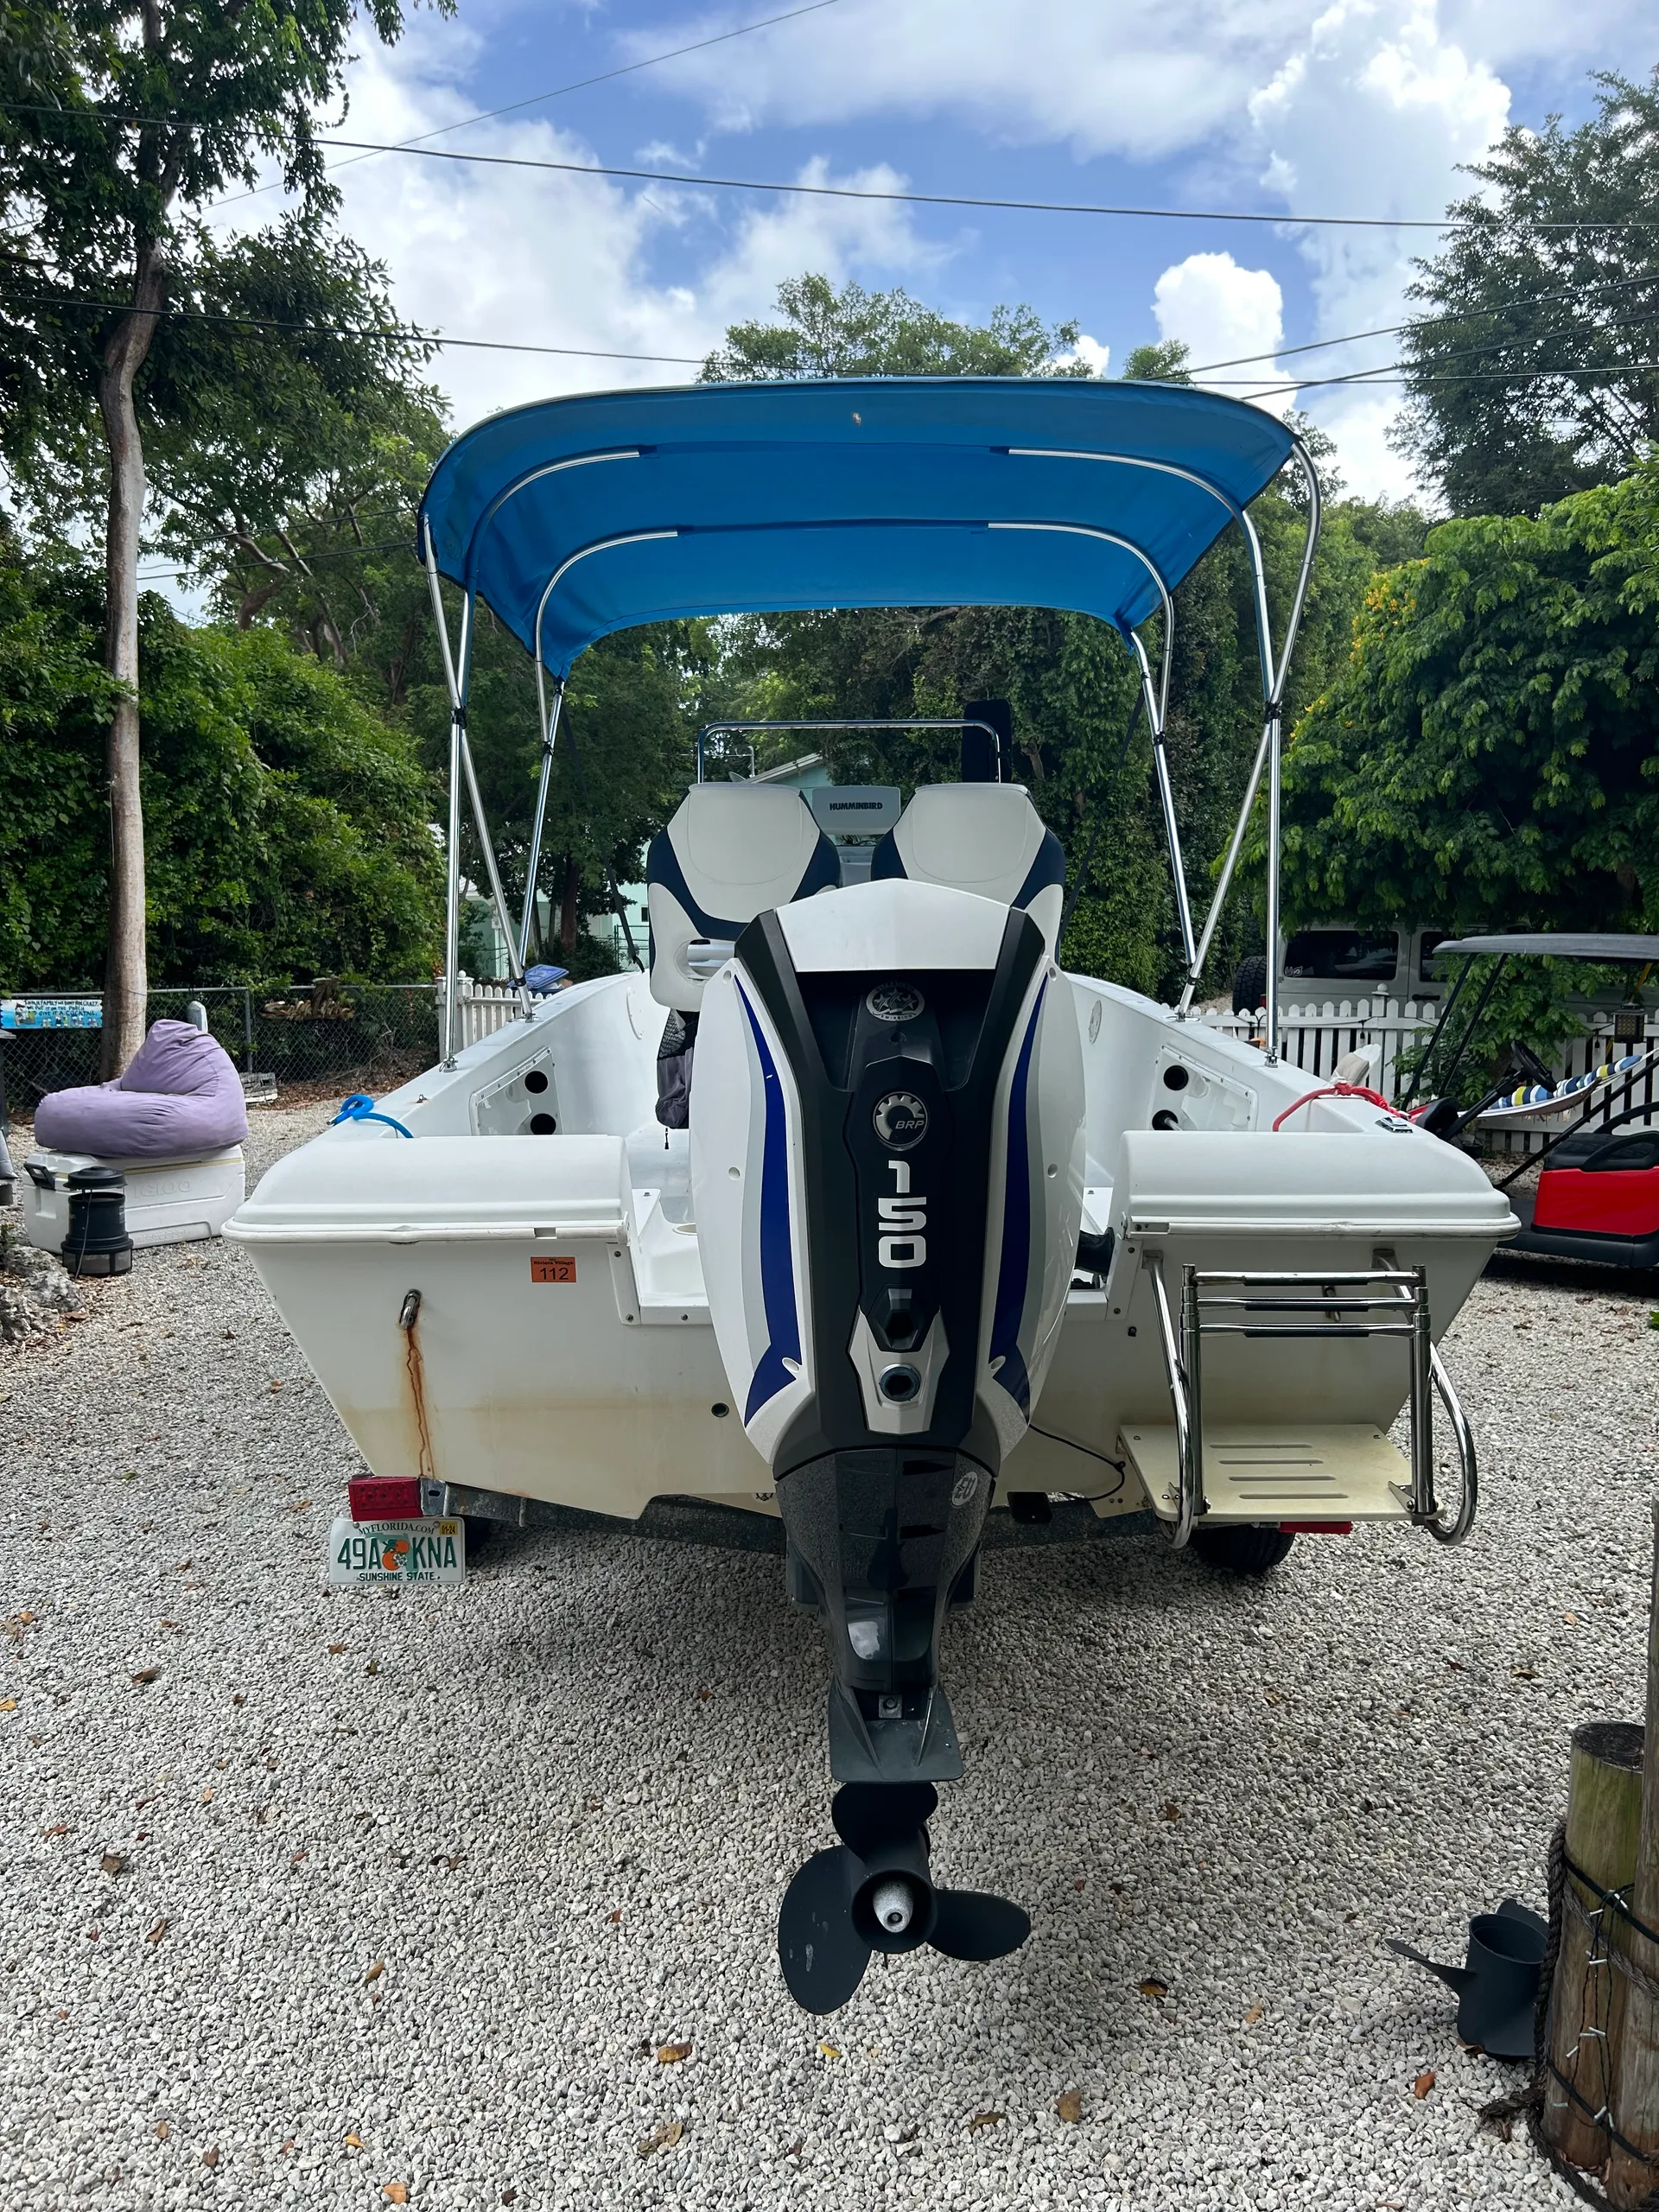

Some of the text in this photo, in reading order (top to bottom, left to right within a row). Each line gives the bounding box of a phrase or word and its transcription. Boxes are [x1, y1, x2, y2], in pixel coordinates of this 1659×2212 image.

[830, 802, 883, 810] HUMMINBIRD
[895, 1120, 925, 1129] BRP
[878, 1160, 927, 1268] 150
[539, 1267, 569, 1280] 112
[359, 1522, 435, 1535] MYFLORIDA.COM
[337, 1536, 458, 1570] 49A KNA
[359, 1571, 435, 1581] SUNSHINE STATE
